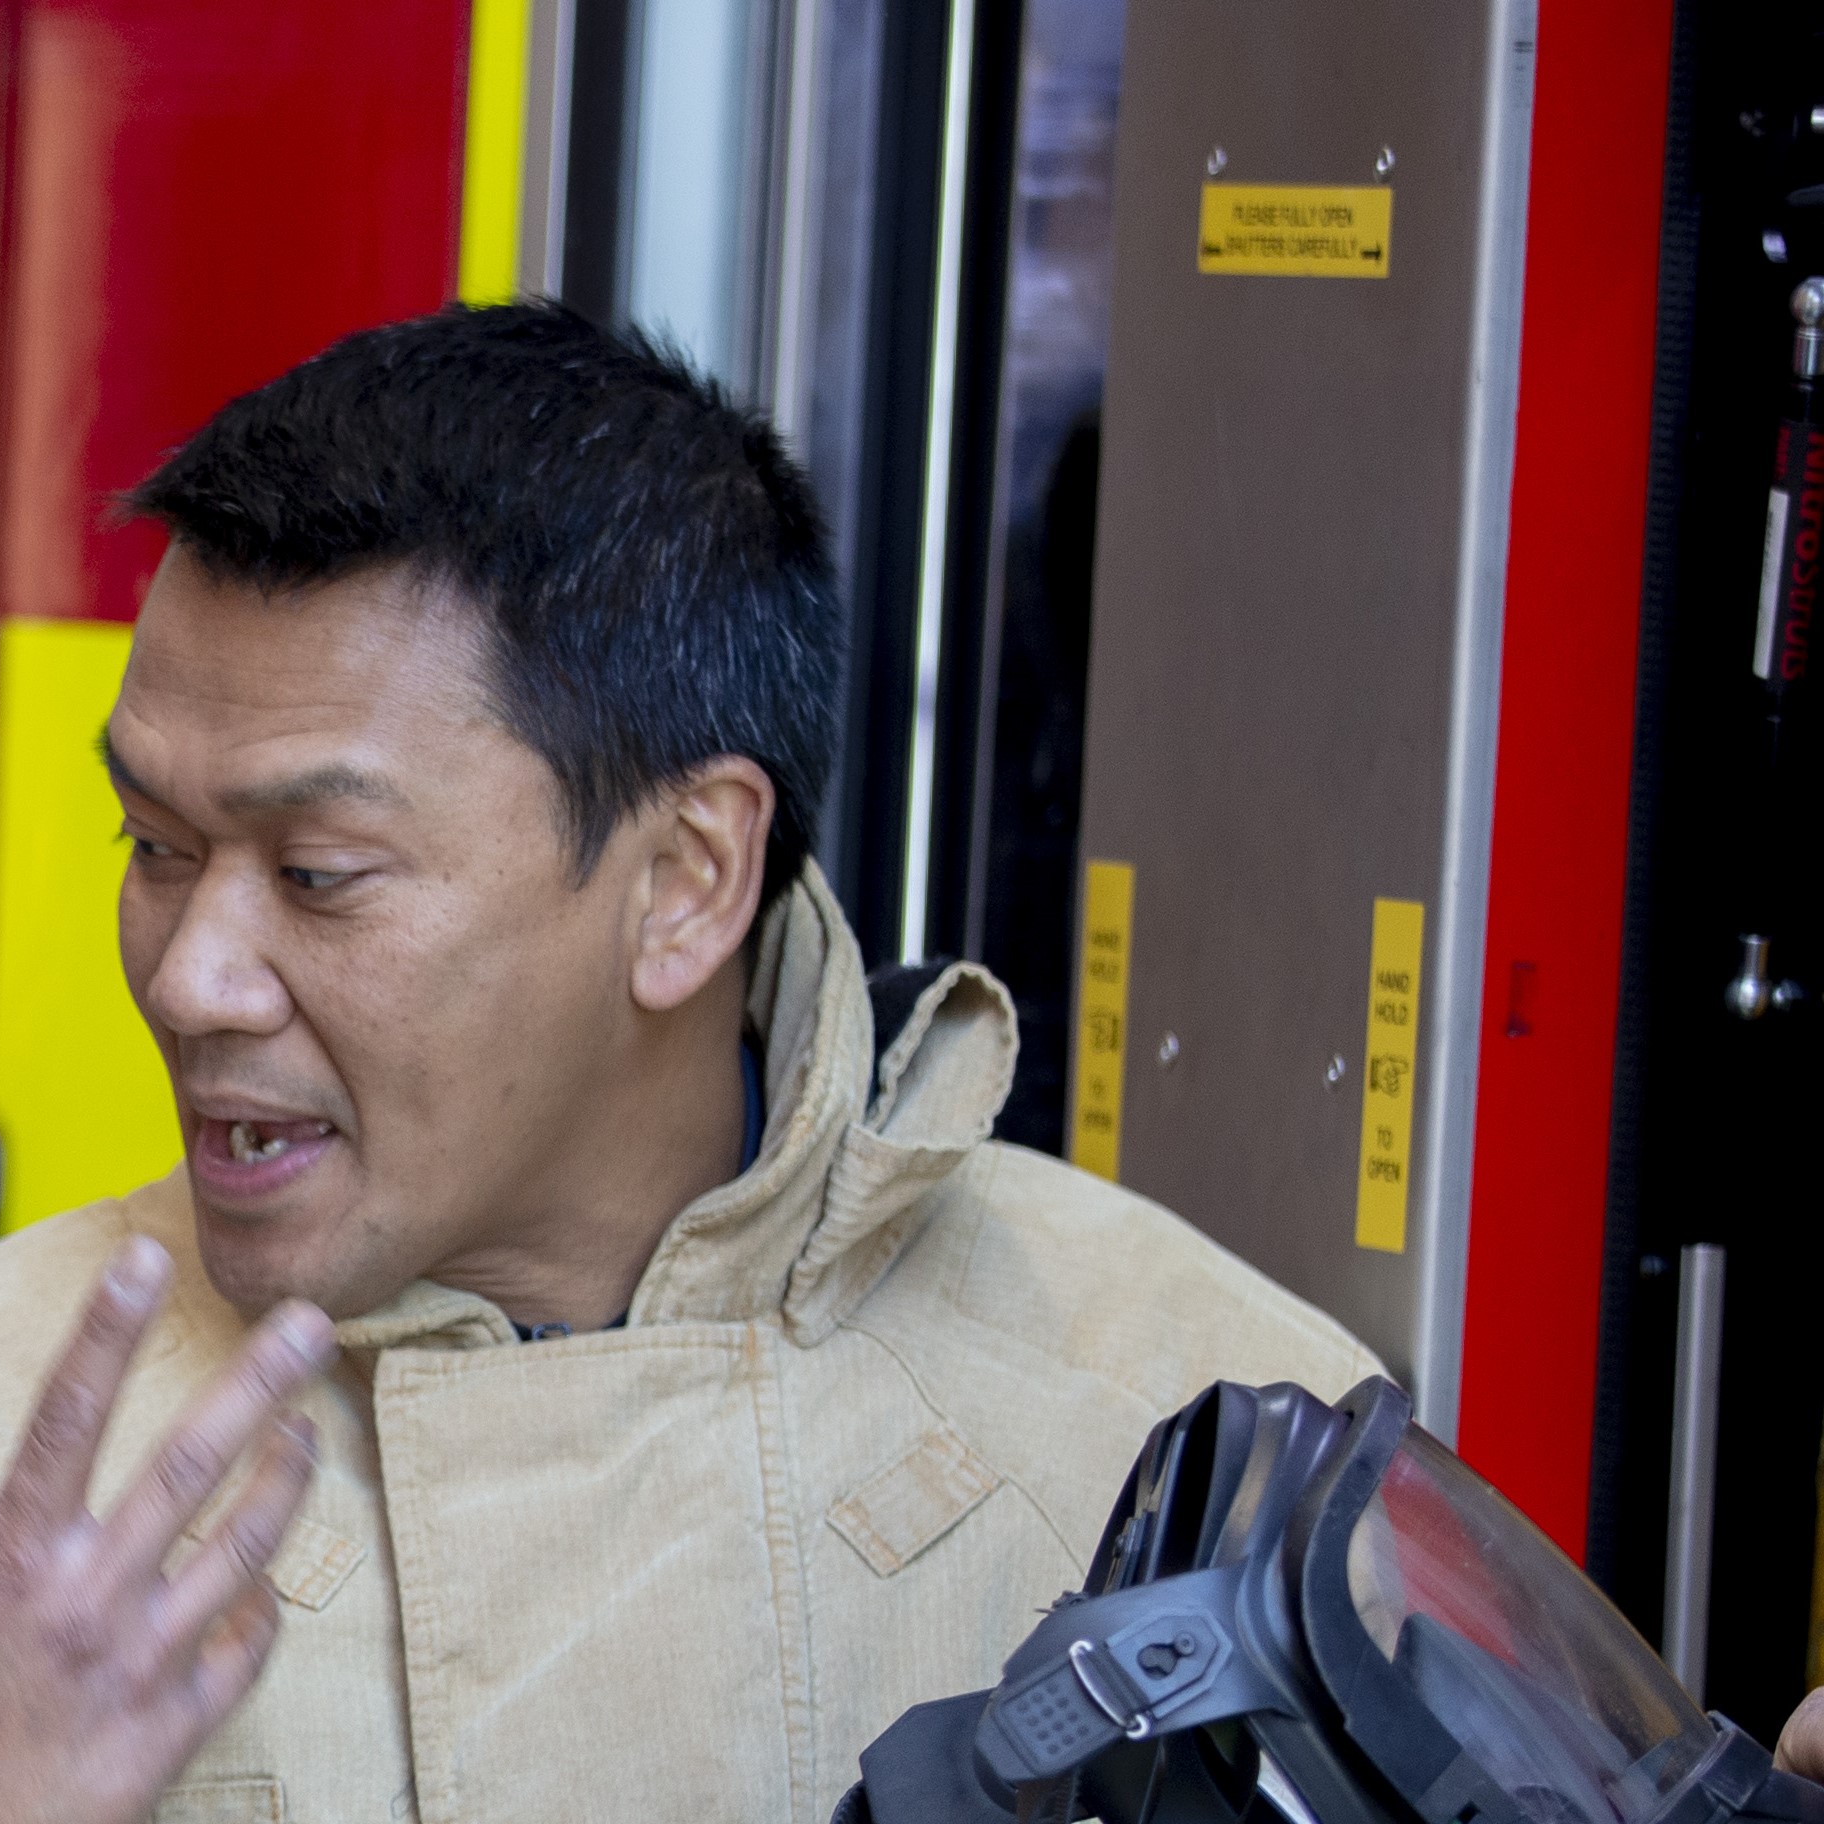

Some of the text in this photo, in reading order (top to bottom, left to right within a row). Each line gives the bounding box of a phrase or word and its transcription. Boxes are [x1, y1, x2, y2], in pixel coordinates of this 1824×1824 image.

[1377, 969, 1410, 995] HAND
[1375, 1001, 1409, 1027] HOLD
[1377, 1125, 1393, 1150] TO
[1367, 1157, 1401, 1185] OPEN
